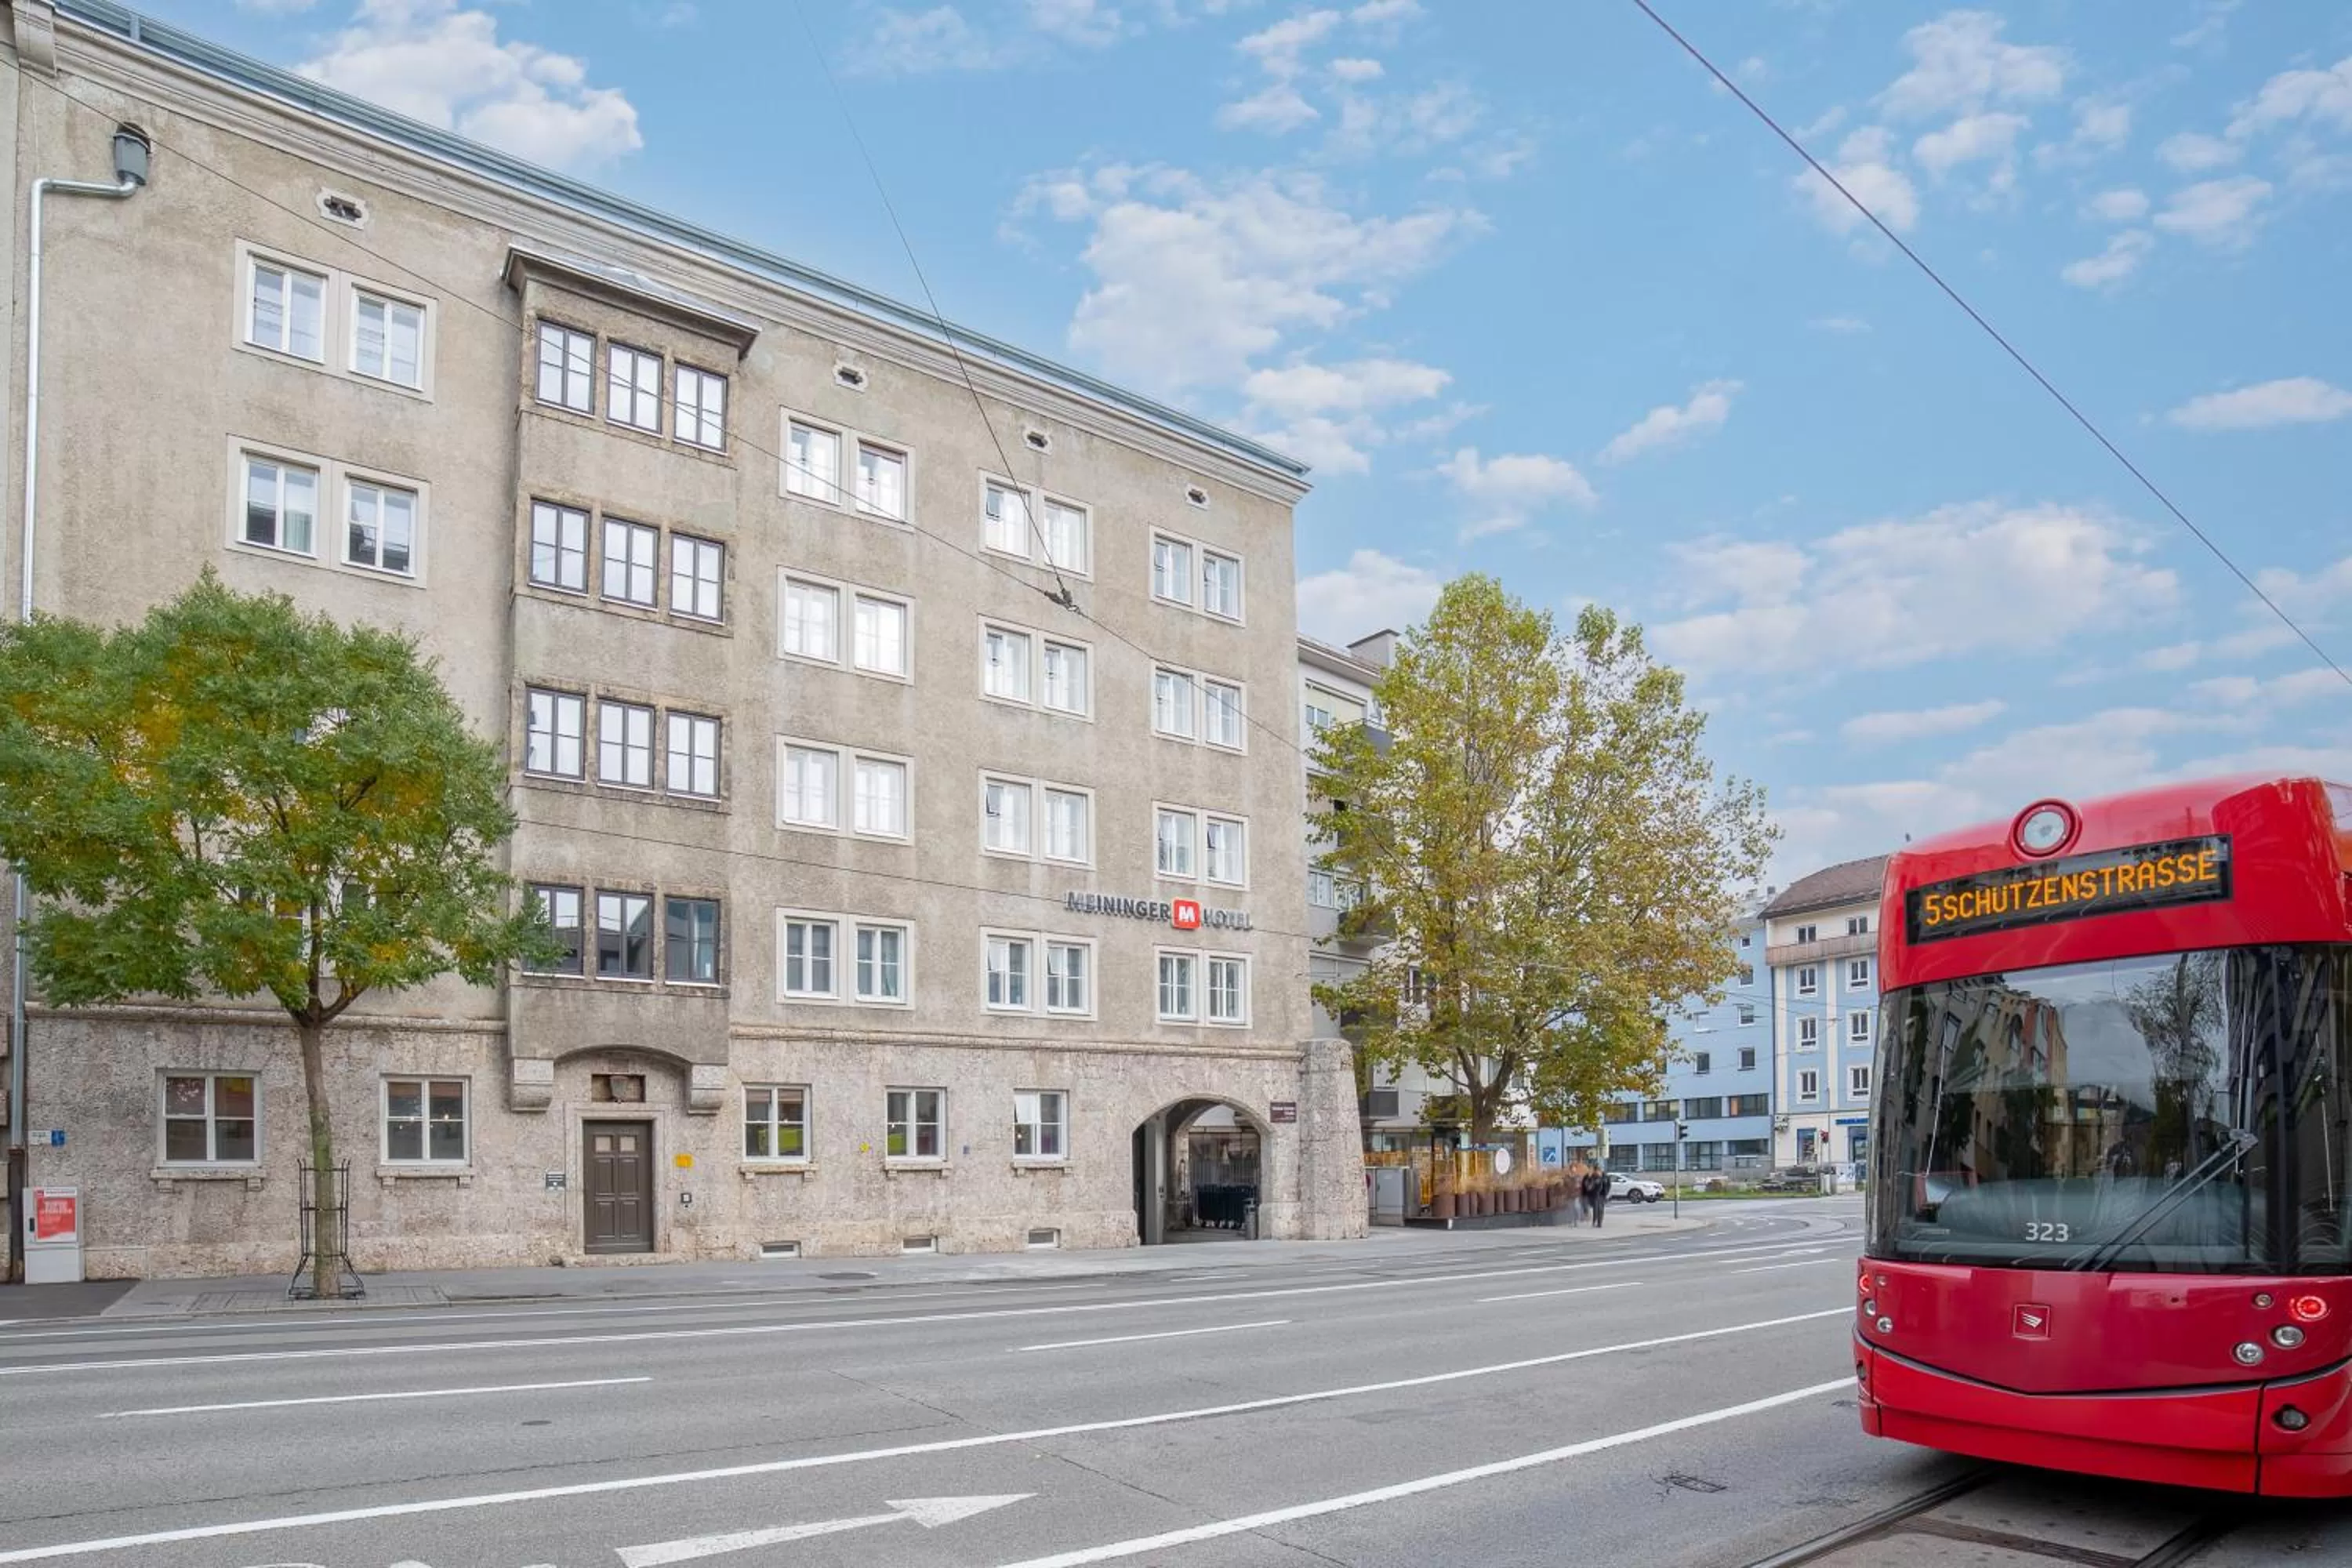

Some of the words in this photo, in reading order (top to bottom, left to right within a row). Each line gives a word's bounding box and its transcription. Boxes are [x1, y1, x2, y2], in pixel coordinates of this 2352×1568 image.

[1065, 891, 1171, 920] MEININGER
[1203, 907, 1253, 930] HOTEL
[2025, 1222, 2069, 1242] 323
